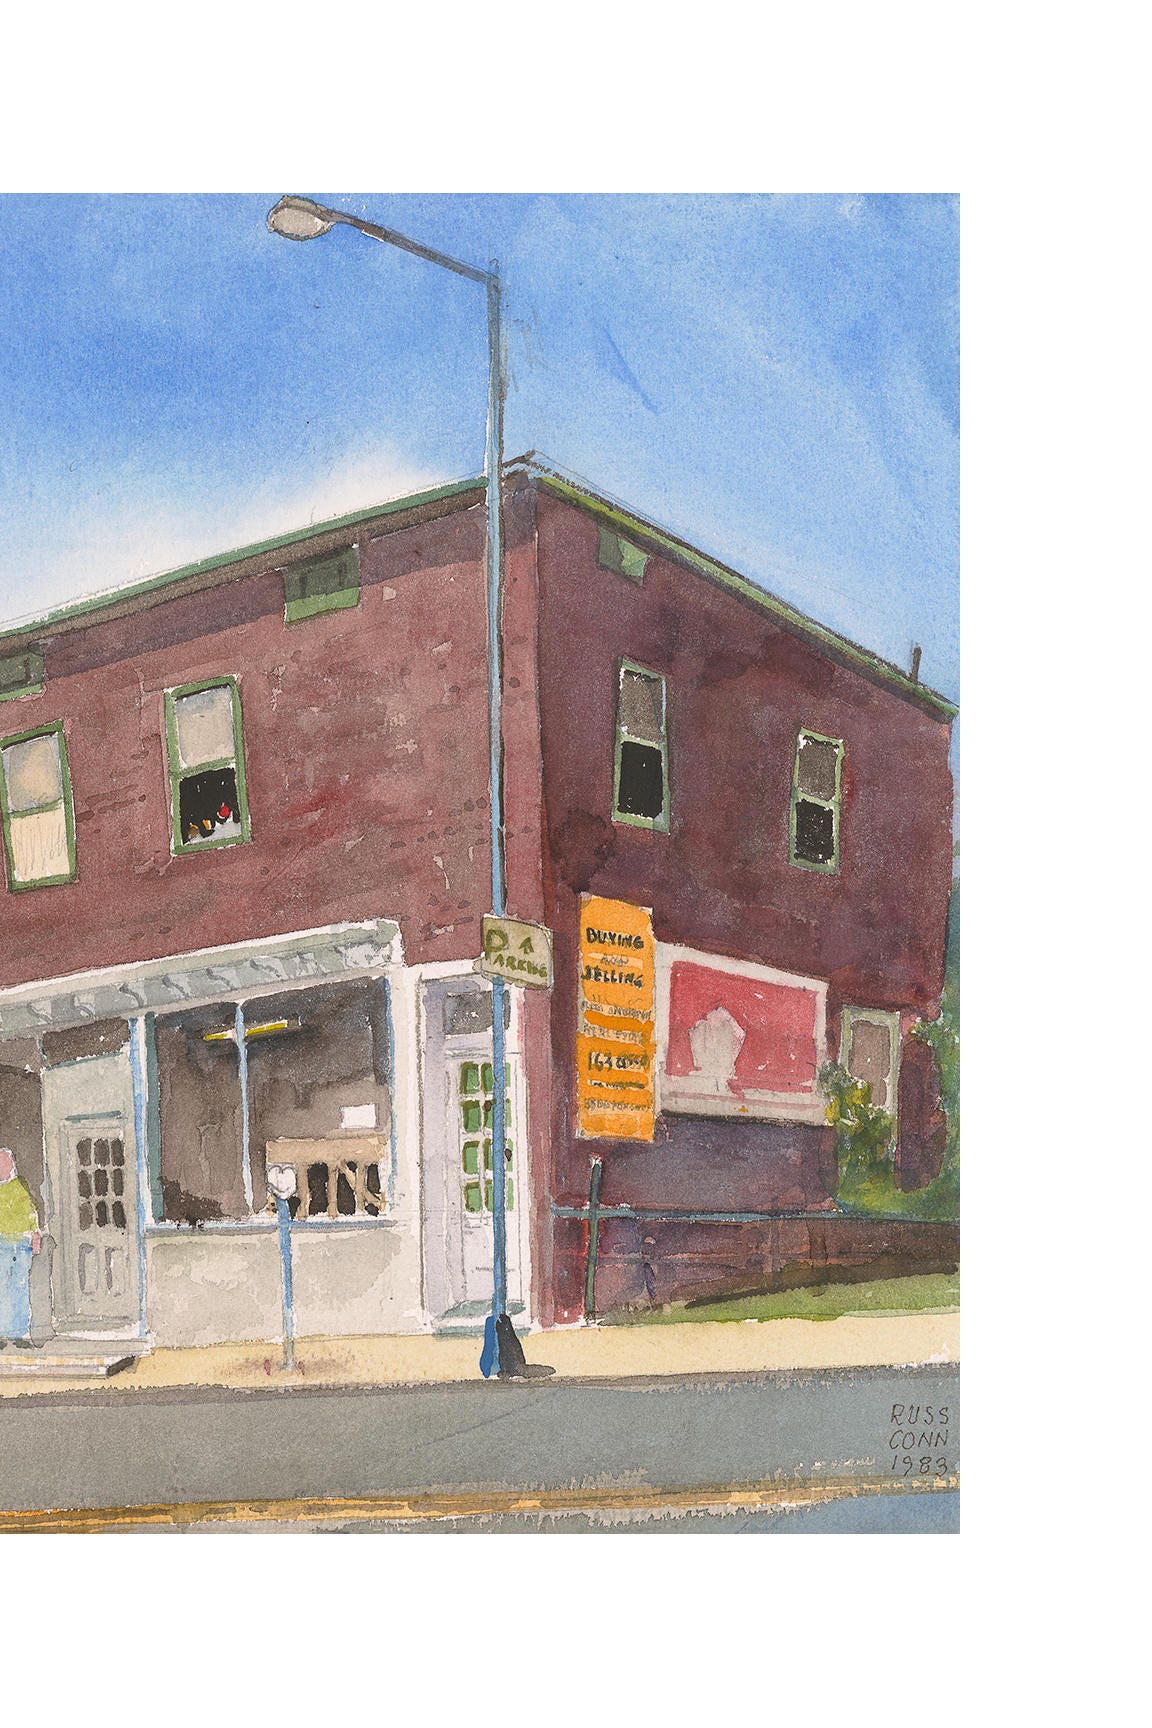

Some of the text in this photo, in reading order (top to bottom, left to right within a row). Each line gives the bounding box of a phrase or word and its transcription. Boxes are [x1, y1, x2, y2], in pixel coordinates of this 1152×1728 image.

[586, 927, 644, 949] BUYING
[581, 965, 644, 988] SELLING
[890, 1403, 949, 1426] RUSS
[889, 1429, 949, 1450] CONN
[891, 1454, 948, 1477] 1983
